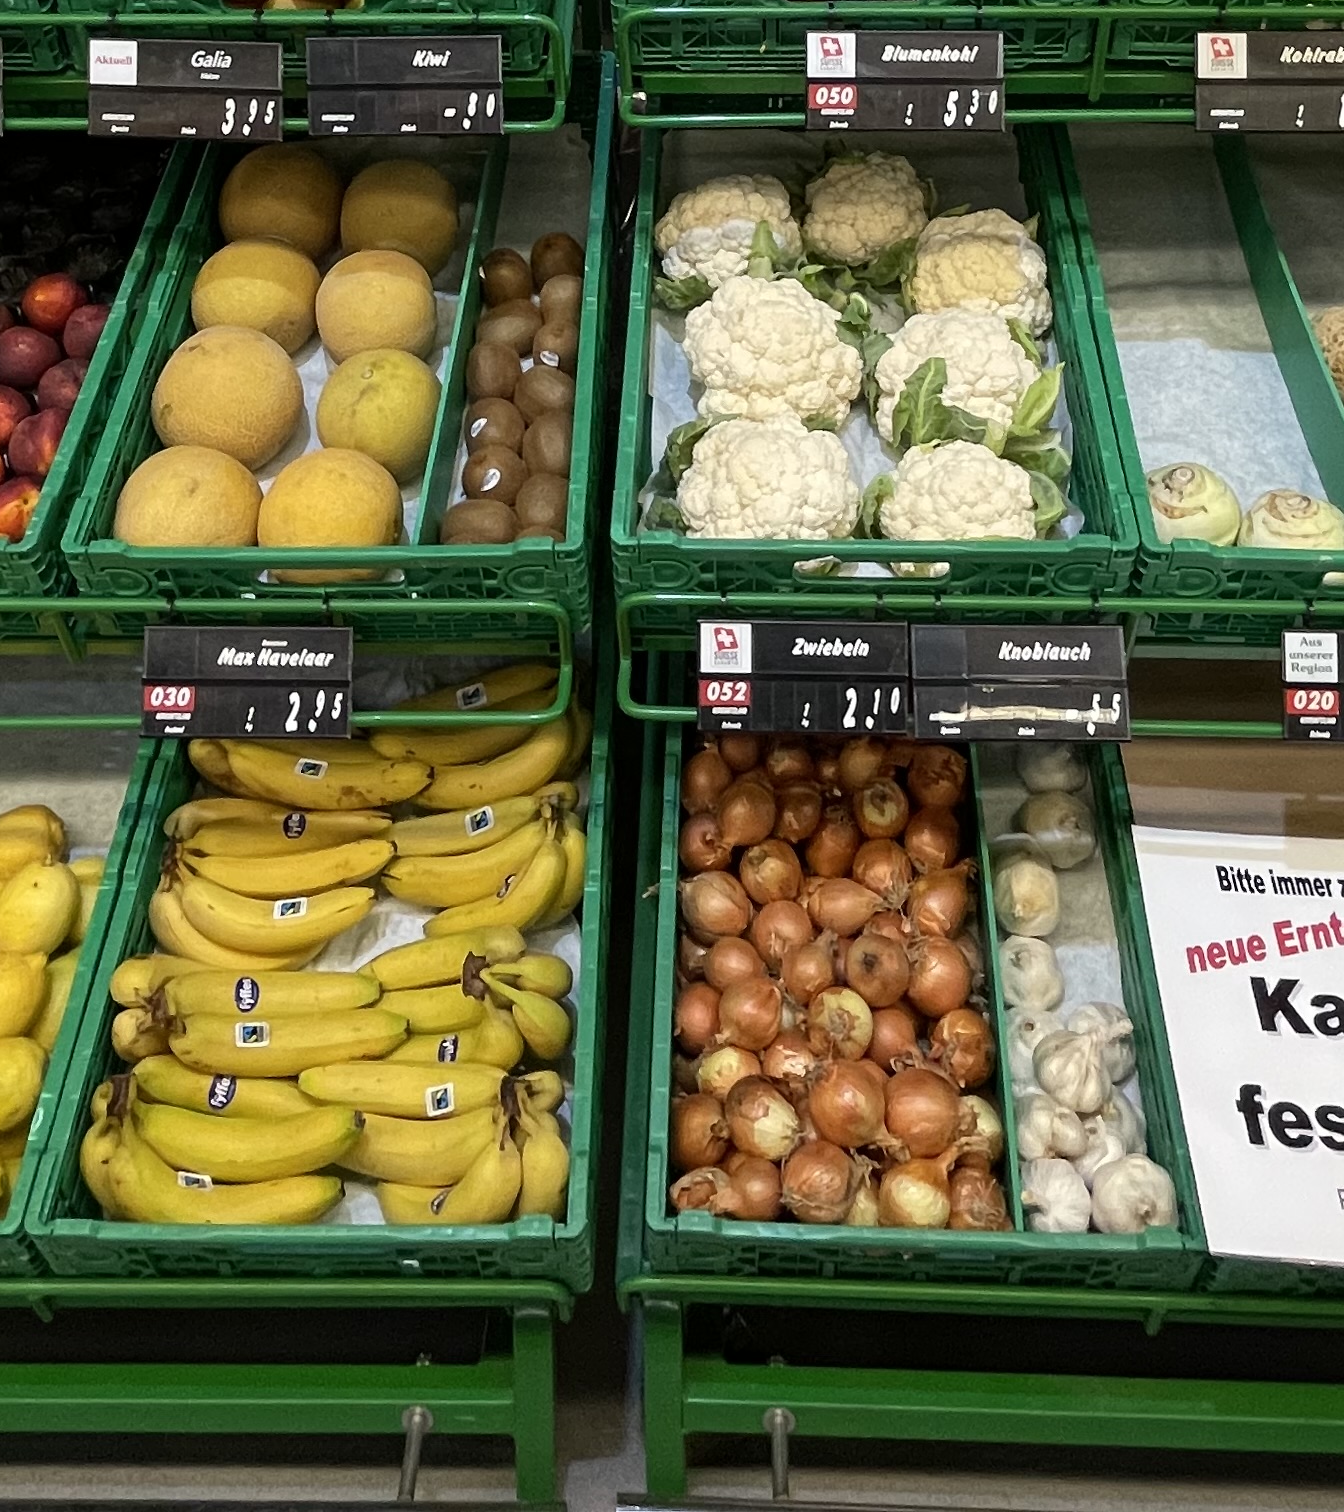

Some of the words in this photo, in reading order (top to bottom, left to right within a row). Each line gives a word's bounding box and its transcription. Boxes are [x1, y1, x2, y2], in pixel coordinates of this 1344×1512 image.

[94, 54, 133, 66] Aktuell
[191, 50, 233, 70] Galia
[412, 49, 451, 68] Kiwi
[881, 44, 980, 63] Blumenkohl
[815, 86, 855, 106] 050
[791, 636, 871, 658] Zwiebeln
[997, 640, 1092, 663] Knoblauch
[1299, 636, 1323, 648] Aus
[217, 646, 256, 666] Max
[257, 648, 335, 667] Havelaar
[1288, 651, 1335, 661] unserer
[1290, 662, 1334, 675] Region
[150, 686, 191, 707] 030
[706, 681, 748, 702] 052
[1292, 689, 1335, 711] 020
[1215, 865, 1267, 896] Bitte
[1268, 870, 1334, 900] immer
[1185, 929, 1267, 974] neue
